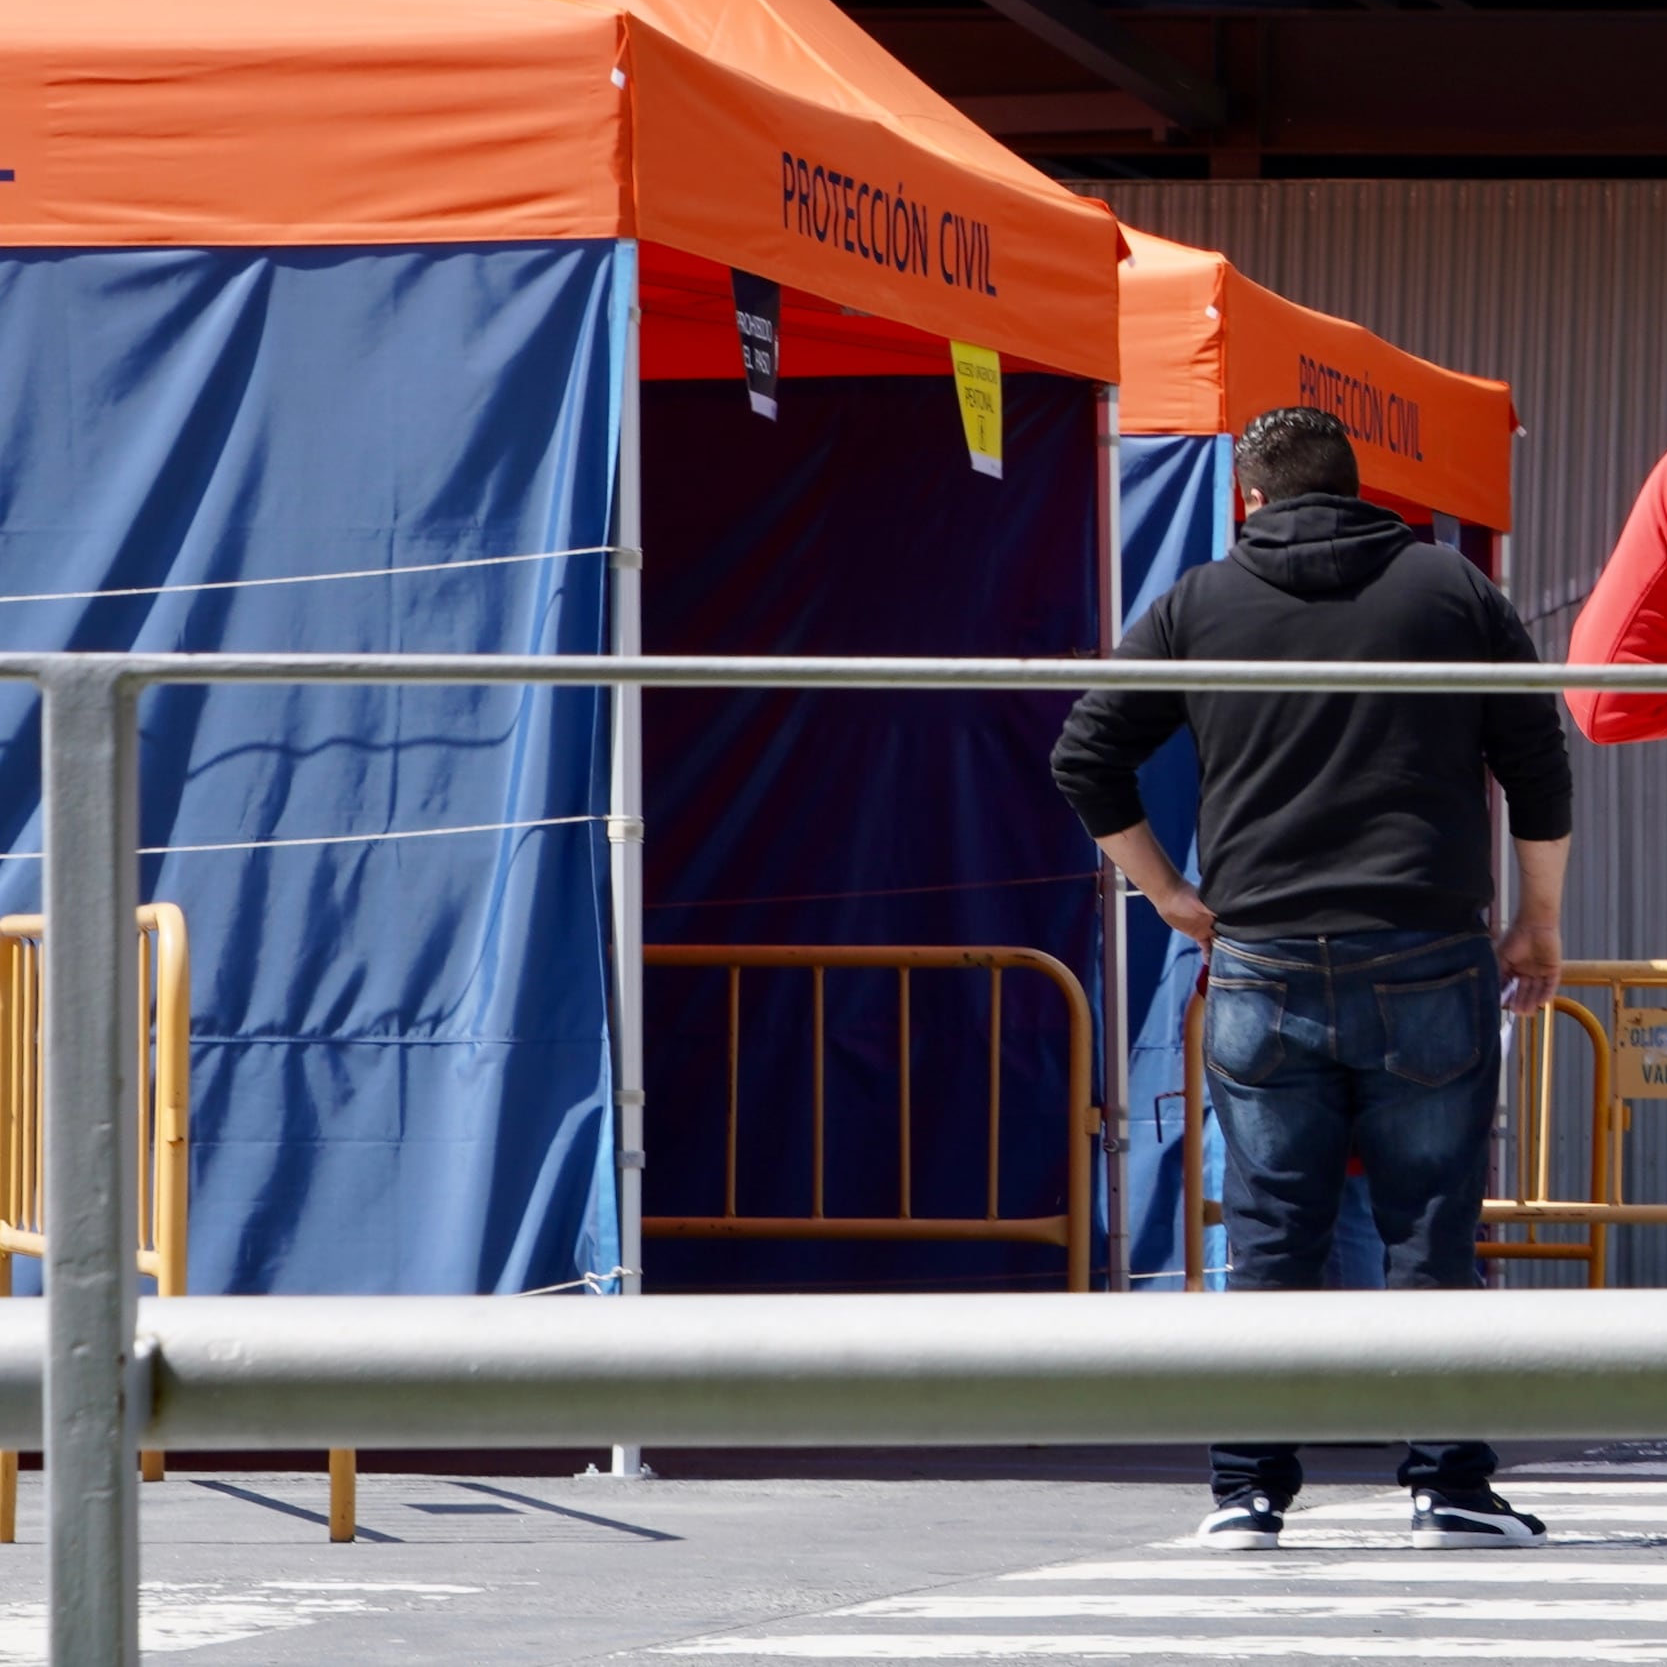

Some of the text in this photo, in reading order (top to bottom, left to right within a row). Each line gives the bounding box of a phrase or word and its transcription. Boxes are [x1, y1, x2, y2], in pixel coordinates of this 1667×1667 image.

[781, 151, 998, 297] PROTECCIÓN CIVIL
[1299, 354, 1424, 462] PROTECCIÓN CIVIL
